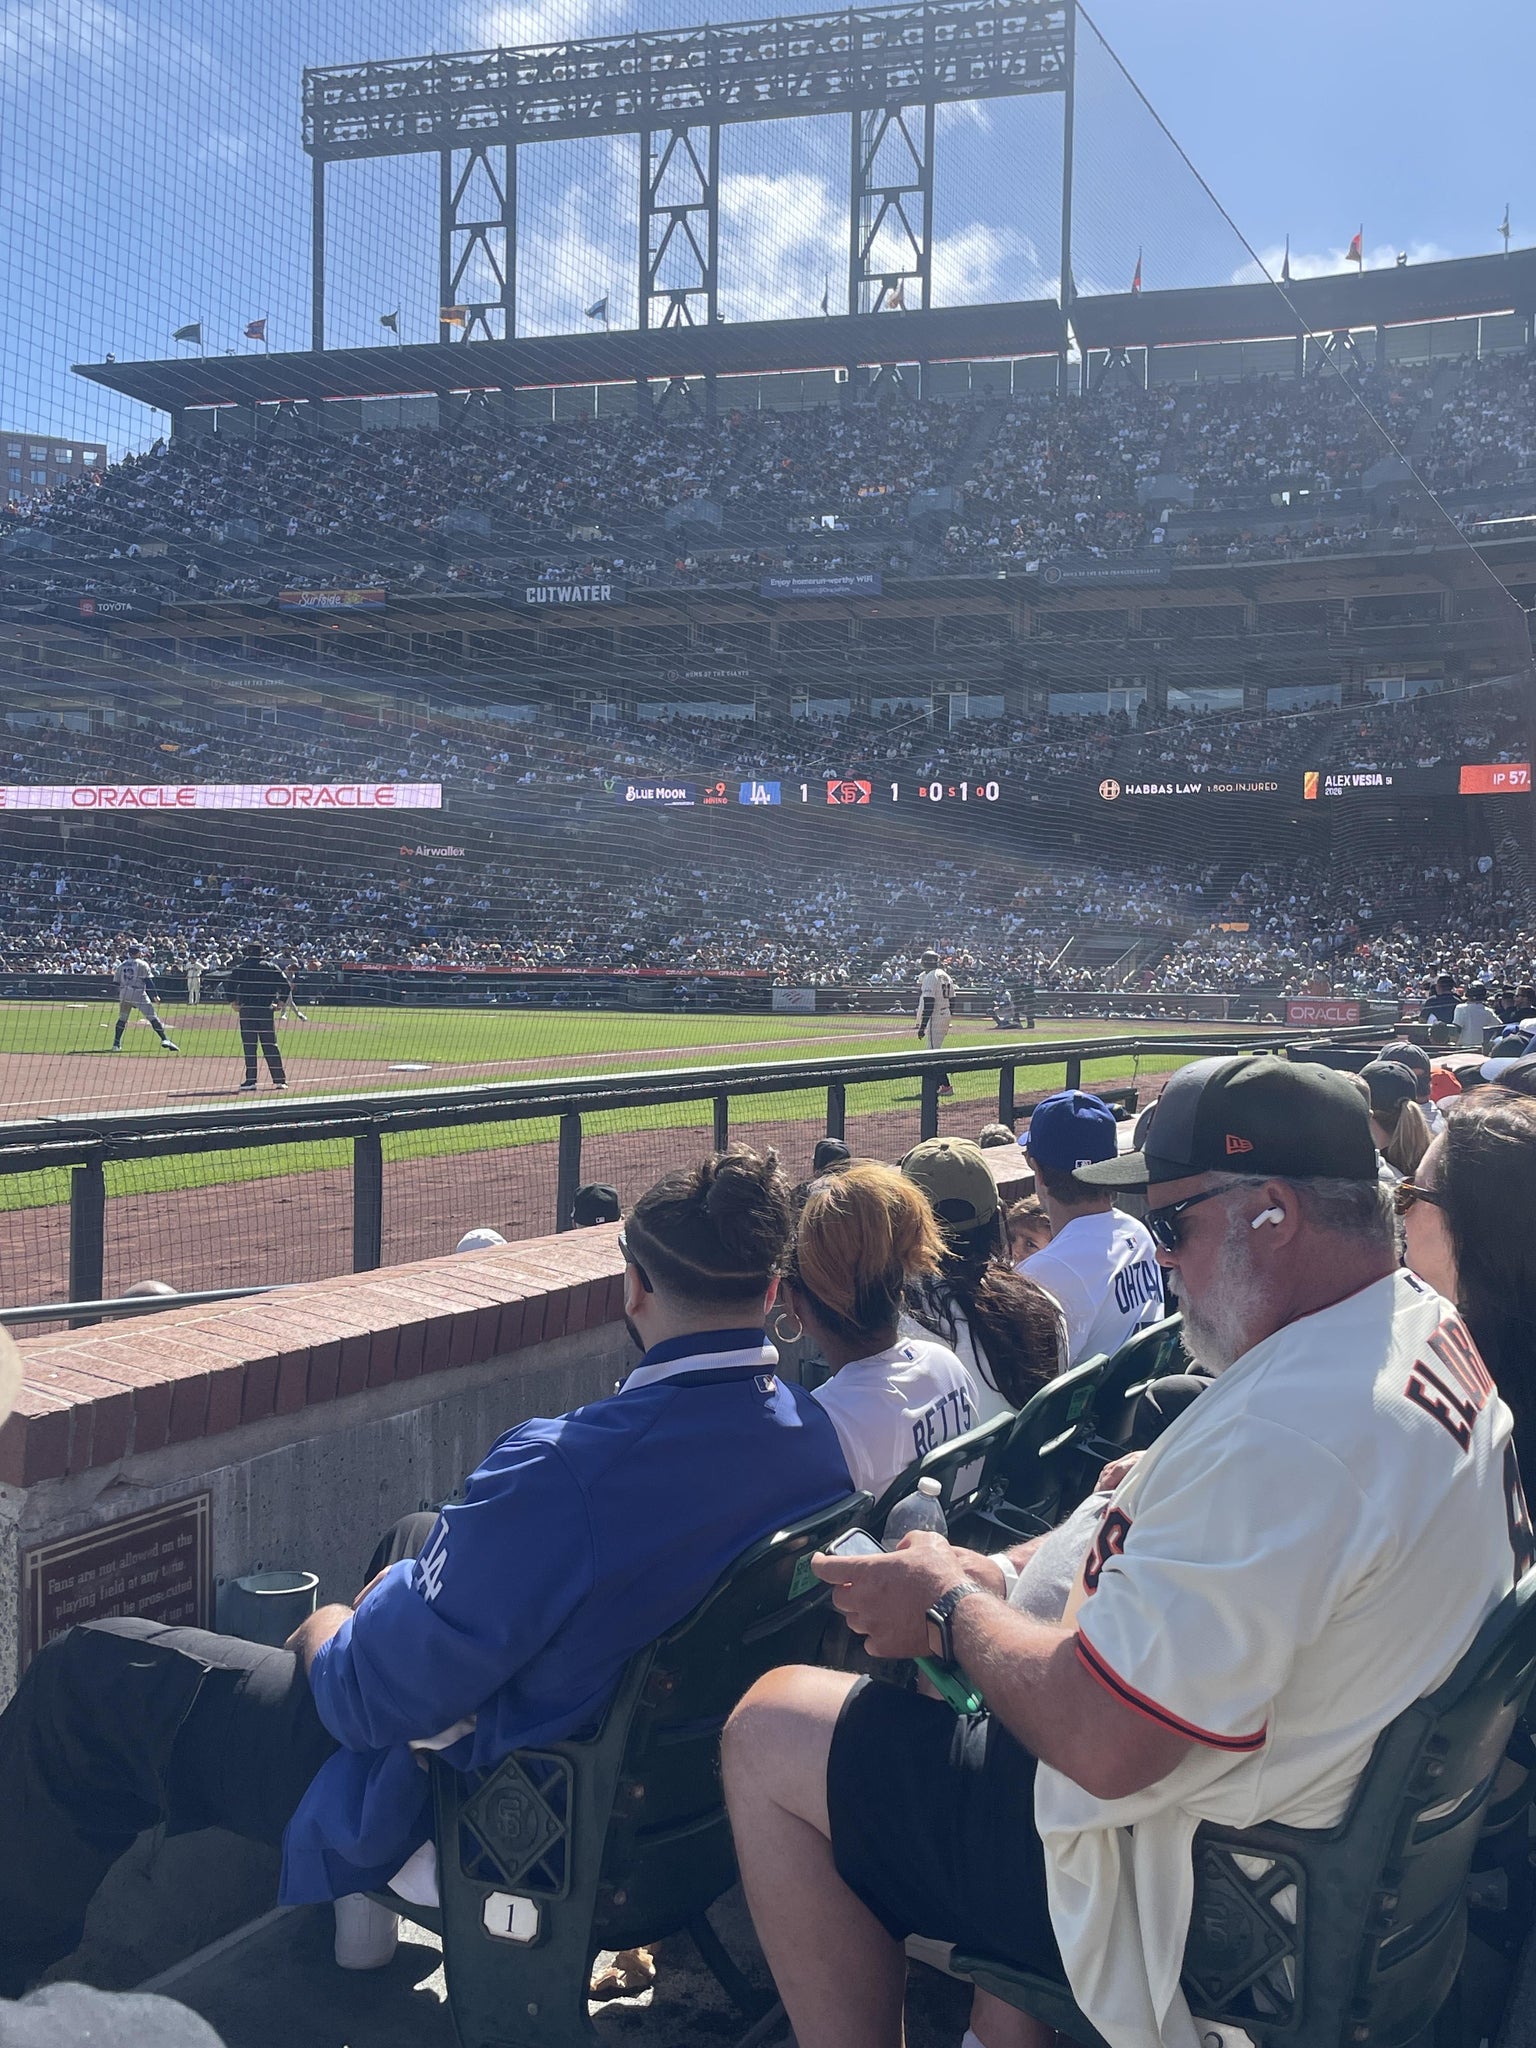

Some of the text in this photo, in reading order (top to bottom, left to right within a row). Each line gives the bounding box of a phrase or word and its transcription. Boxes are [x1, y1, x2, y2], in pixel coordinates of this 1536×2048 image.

[300, 592, 341, 607] Surfside
[526, 585, 611, 603] CUTWATER
[97, 603, 132, 611] TOYOTA
[715, 782, 726, 796] 9
[1125, 784, 1173, 795] HABBAS
[1175, 783, 1202, 794] LAW
[1324, 775, 1350, 786] ALEX
[1352, 773, 1383, 786] VESIA
[1493, 773, 1505, 785] IP
[71, 787, 196, 807] ORACLE
[265, 786, 395, 806] ORACLE
[625, 785, 686, 801] BLUE MOON
[749, 781, 771, 805] LA
[800, 783, 808, 802] 1
[840, 783, 857, 803] SF
[890, 782, 899, 802] 1
[929, 782, 943, 802] 0
[960, 781, 968, 801] 1
[985, 781, 1000, 802] 0
[415, 845, 465, 857] Airwallex
[1290, 1007, 1358, 1020] ORACLE
[1404, 1312, 1497, 1455] ELDR
[912, 1386, 970, 1460] BETTS
[48, 1533, 193, 1595] Fans are not allowed on the
[414, 1515, 450, 1603] LA
[55, 1592, 96, 1619] playing
[100, 1578, 125, 1600] field
[128, 1578, 138, 1590] at
[140, 1569, 159, 1586] any
[123, 1600, 136, 1615] be
[169, 1608, 182, 1621] up
[185, 1601, 194, 1612] to
[506, 1903, 514, 1933] 1
